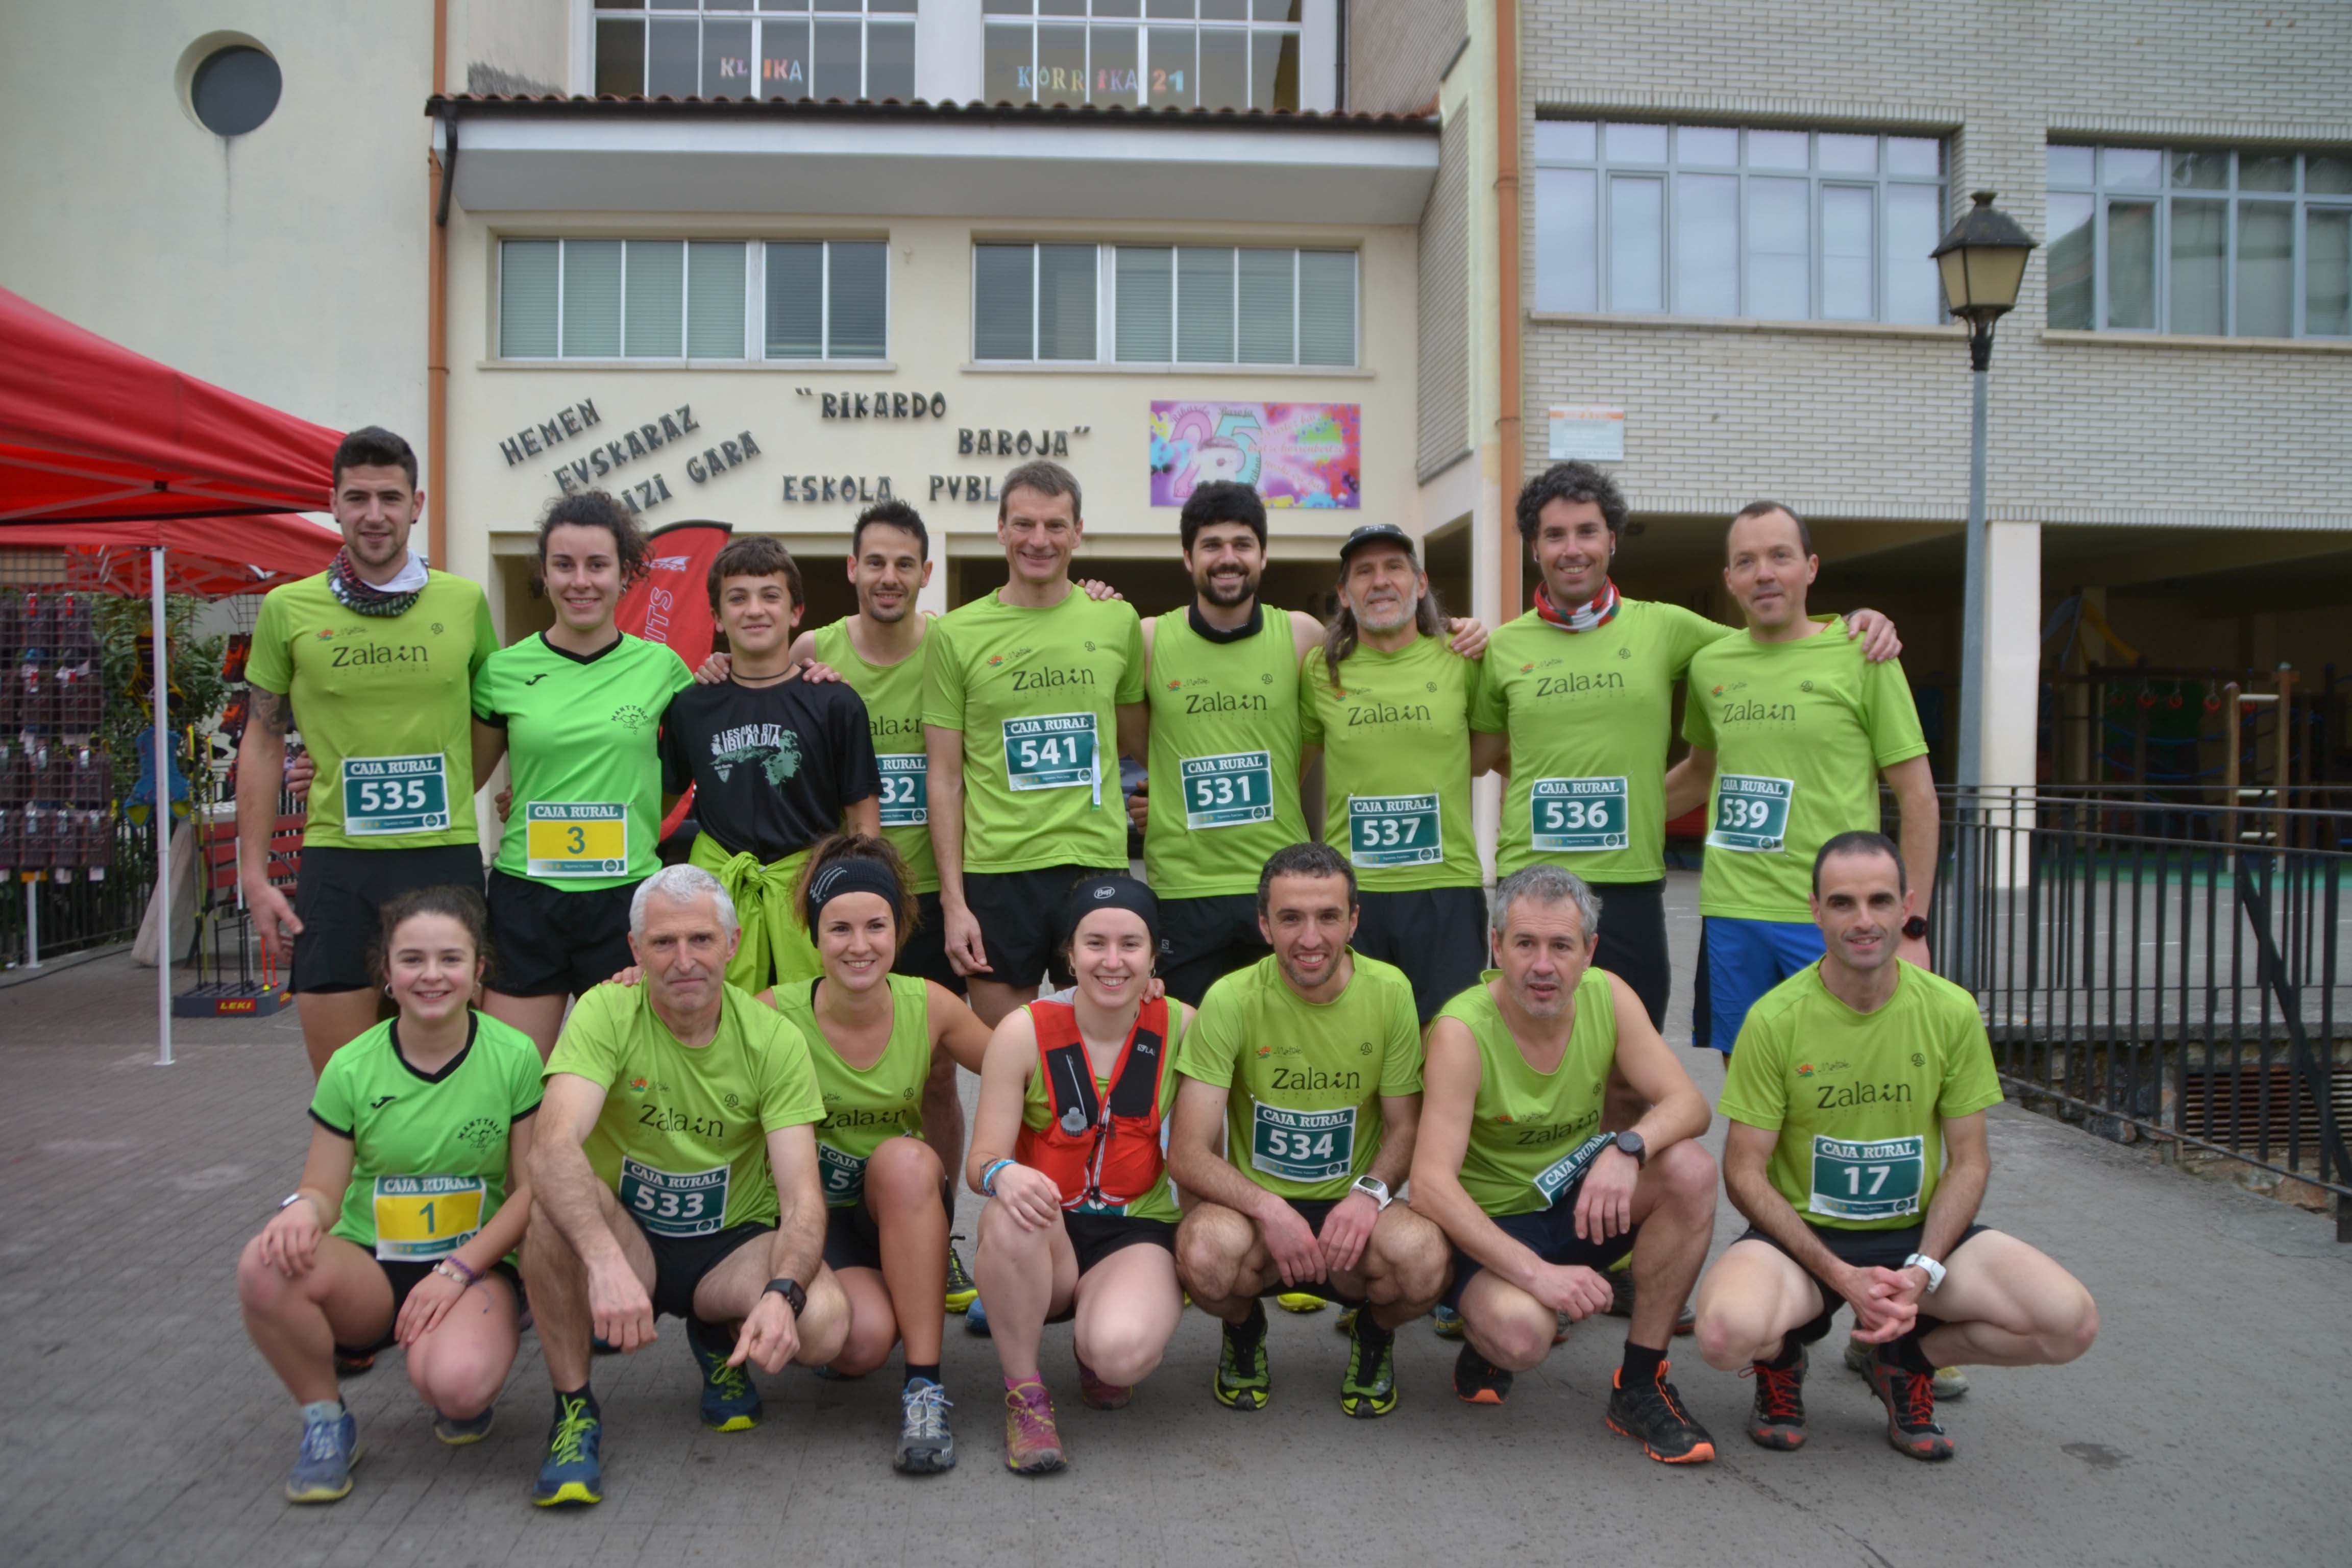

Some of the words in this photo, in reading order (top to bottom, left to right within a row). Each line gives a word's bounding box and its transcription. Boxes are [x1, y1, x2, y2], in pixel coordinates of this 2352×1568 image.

[1153, 68, 1184, 92] 21
[499, 398, 601, 467] HEMEN
[621, 474, 673, 514] IZI
[686, 430, 761, 483] GARA
[782, 475, 892, 502] ESKOLA
[332, 642, 428, 668] Zalain
[1012, 666, 1095, 691] Zalain
[1536, 672, 1624, 697] Zalain
[1186, 691, 1267, 714] Zalain
[1348, 702, 1431, 726] Zalain
[1723, 699, 1796, 724] Zalain
[1010, 721, 1042, 734] CAJA
[1044, 717, 1089, 731] RURAL
[882, 758, 926, 770] RURAL
[1020, 736, 1077, 768] 541
[1187, 761, 1217, 773] CAJA
[1218, 756, 1263, 770] RURAL
[350, 762, 385, 775] CAJA
[387, 759, 436, 774] RURAL
[360, 779, 427, 812] 535
[878, 776, 916, 804] 32
[1197, 775, 1251, 806] 531
[1538, 783, 1570, 794] CAJA
[1572, 781, 1620, 794] RURAL
[1722, 779, 1739, 791] CAJA
[1740, 780, 1784, 795] RURAL
[534, 806, 568, 818] CAJA
[570, 806, 618, 818] RURAL
[1354, 801, 1384, 813] CAJA
[1386, 799, 1432, 812] RURAL
[1546, 800, 1609, 829] 536
[1722, 798, 1769, 828] 539
[567, 826, 585, 854] 3
[1363, 817, 1421, 846] 537
[219, 1001, 252, 1010] LEKI
[1271, 1067, 1360, 1090] Zalain
[1817, 1081, 1912, 1109] Zalain
[639, 1104, 723, 1137] Zalain
[1263, 1109, 1296, 1126] CAJA
[1300, 1113, 1348, 1128] RURAL
[1516, 1110, 1599, 1145] Zalain
[1268, 1129, 1334, 1160] 534
[1822, 1142, 1859, 1159] CAJA
[1863, 1142, 1916, 1159] RURAL
[827, 1150, 860, 1168] CAJA
[1545, 1160, 1577, 1186] CAJA
[1574, 1134, 1607, 1165] RURAL
[384, 1178, 420, 1193] CAJA
[422, 1178, 476, 1192] RURAL
[631, 1164, 665, 1186] CAJA
[667, 1173, 721, 1188] RURAL
[1844, 1165, 1891, 1195] 17
[634, 1184, 704, 1218] 533
[419, 1201, 435, 1234] 1
